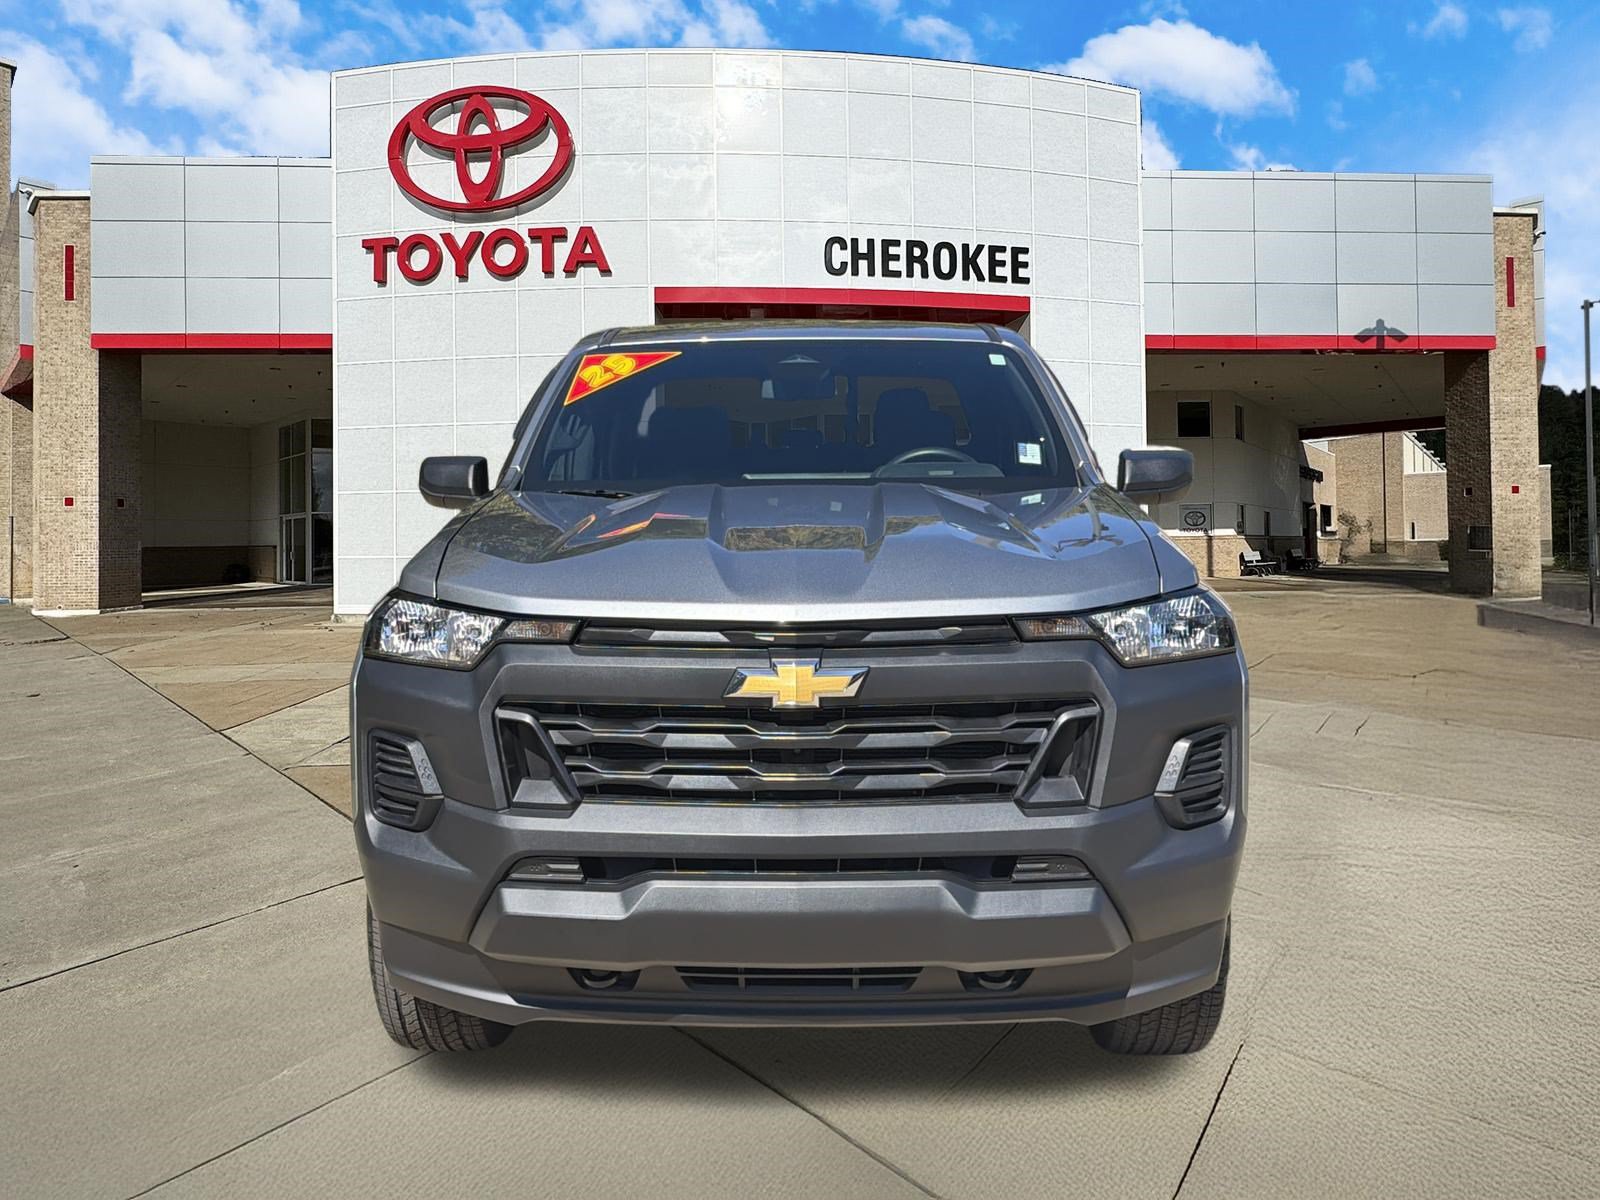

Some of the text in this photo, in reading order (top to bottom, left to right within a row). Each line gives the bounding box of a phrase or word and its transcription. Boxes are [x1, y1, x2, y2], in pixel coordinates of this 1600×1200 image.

[362, 226, 612, 286] TOYOTA
[824, 236, 1031, 284] CHEROKEE
[579, 354, 636, 388] 25
